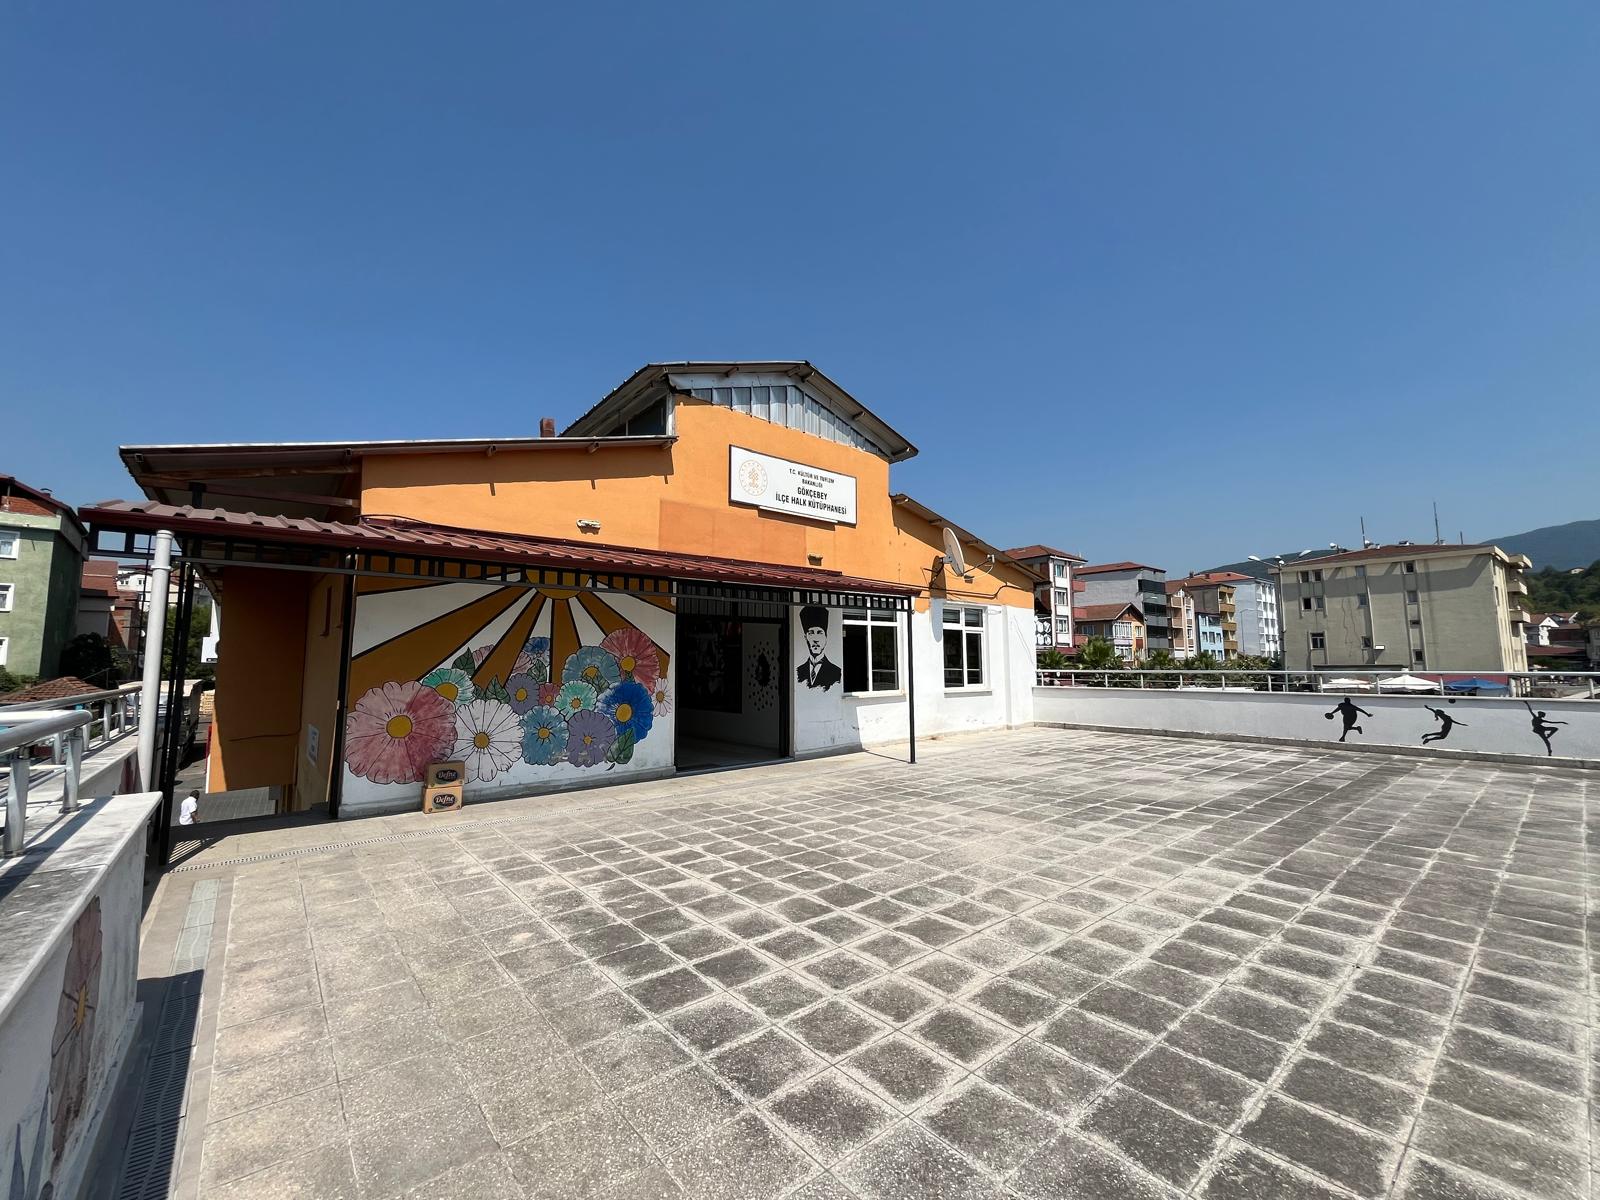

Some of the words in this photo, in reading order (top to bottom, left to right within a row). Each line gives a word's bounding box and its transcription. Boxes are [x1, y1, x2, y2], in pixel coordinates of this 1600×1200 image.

[797, 486, 828, 500] GÖKÇEBEY
[775, 491, 790, 504] İLÇE
[791, 496, 806, 506] HALK
[808, 499, 847, 514] KÜTÜPHANESİ
[435, 795, 454, 804] Defne
